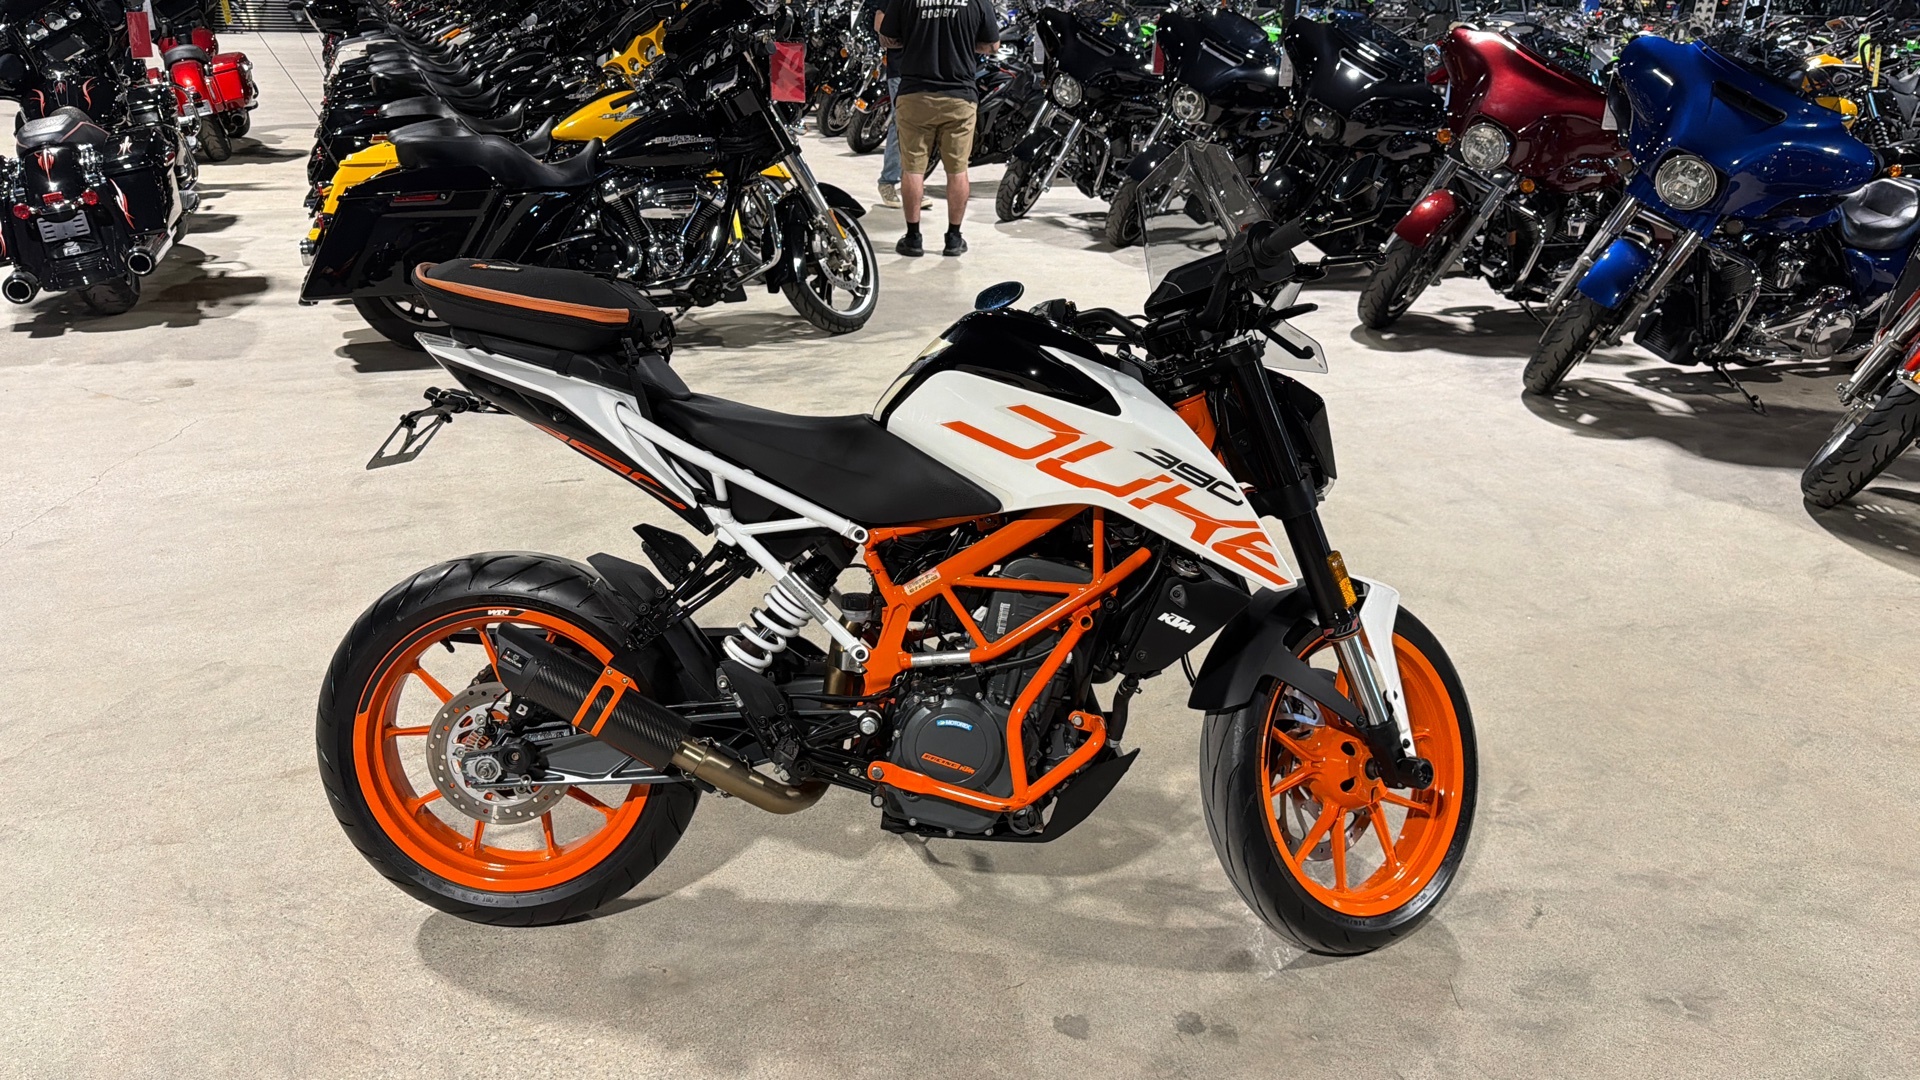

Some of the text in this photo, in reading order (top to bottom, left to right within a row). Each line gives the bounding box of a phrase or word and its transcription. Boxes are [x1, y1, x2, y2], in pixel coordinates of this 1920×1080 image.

[921, 8, 959, 20] SOCIETY
[1133, 447, 1244, 507] 390
[940, 404, 1291, 586] DUKE
[1157, 612, 1197, 634] KTM
[945, 719, 973, 731] MOTOREX
